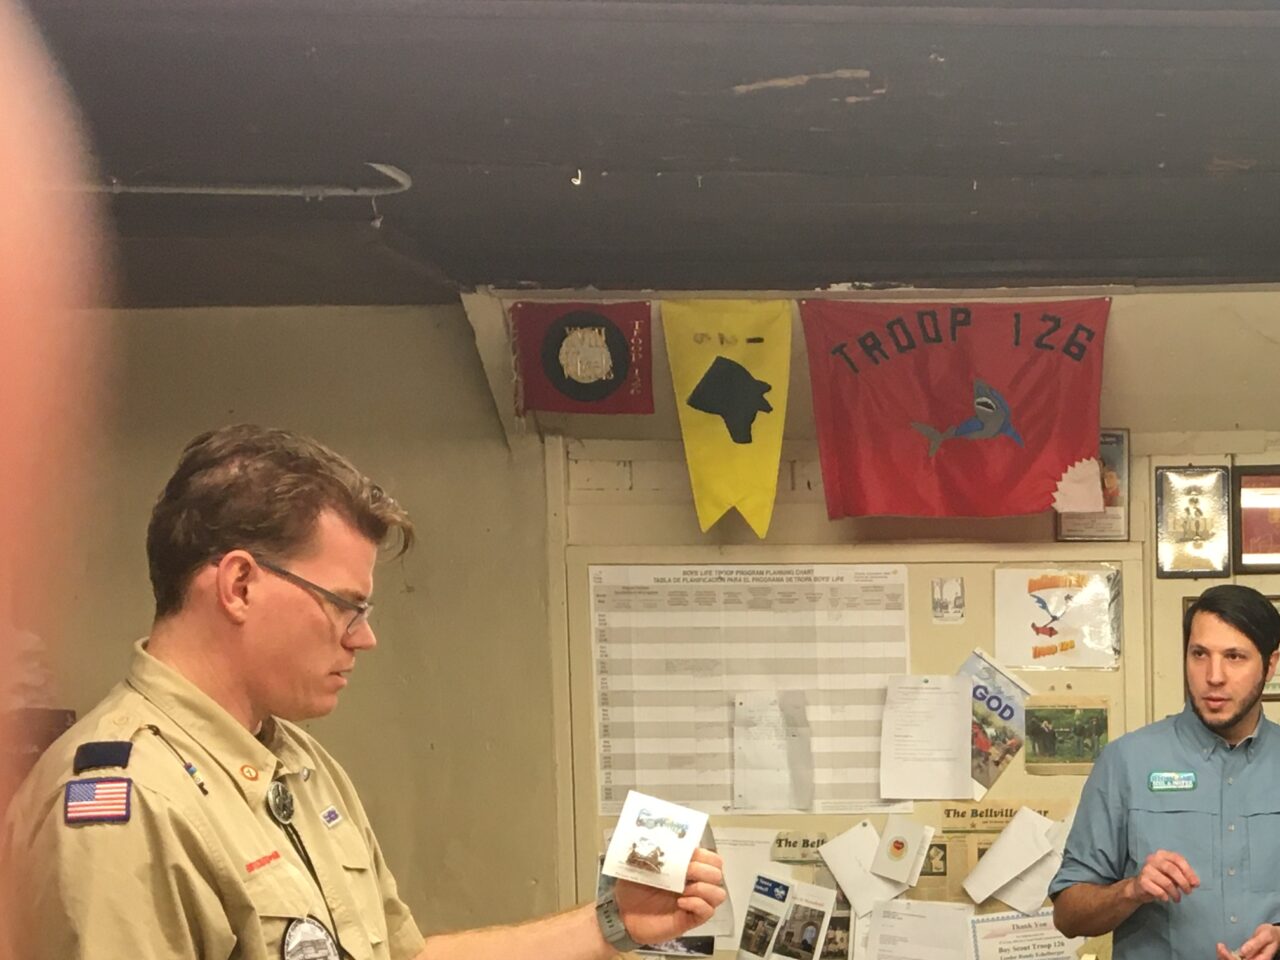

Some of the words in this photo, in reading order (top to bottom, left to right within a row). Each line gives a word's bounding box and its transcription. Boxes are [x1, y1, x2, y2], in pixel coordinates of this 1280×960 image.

[831, 307, 971, 374] TROOP
[1013, 312, 1095, 361] 126
[972, 684, 1014, 721] GOD
[944, 808, 967, 818] The
[776, 838, 798, 848] The
[802, 838, 825, 848] Bell
[1032, 943, 1052, 951] Troop
